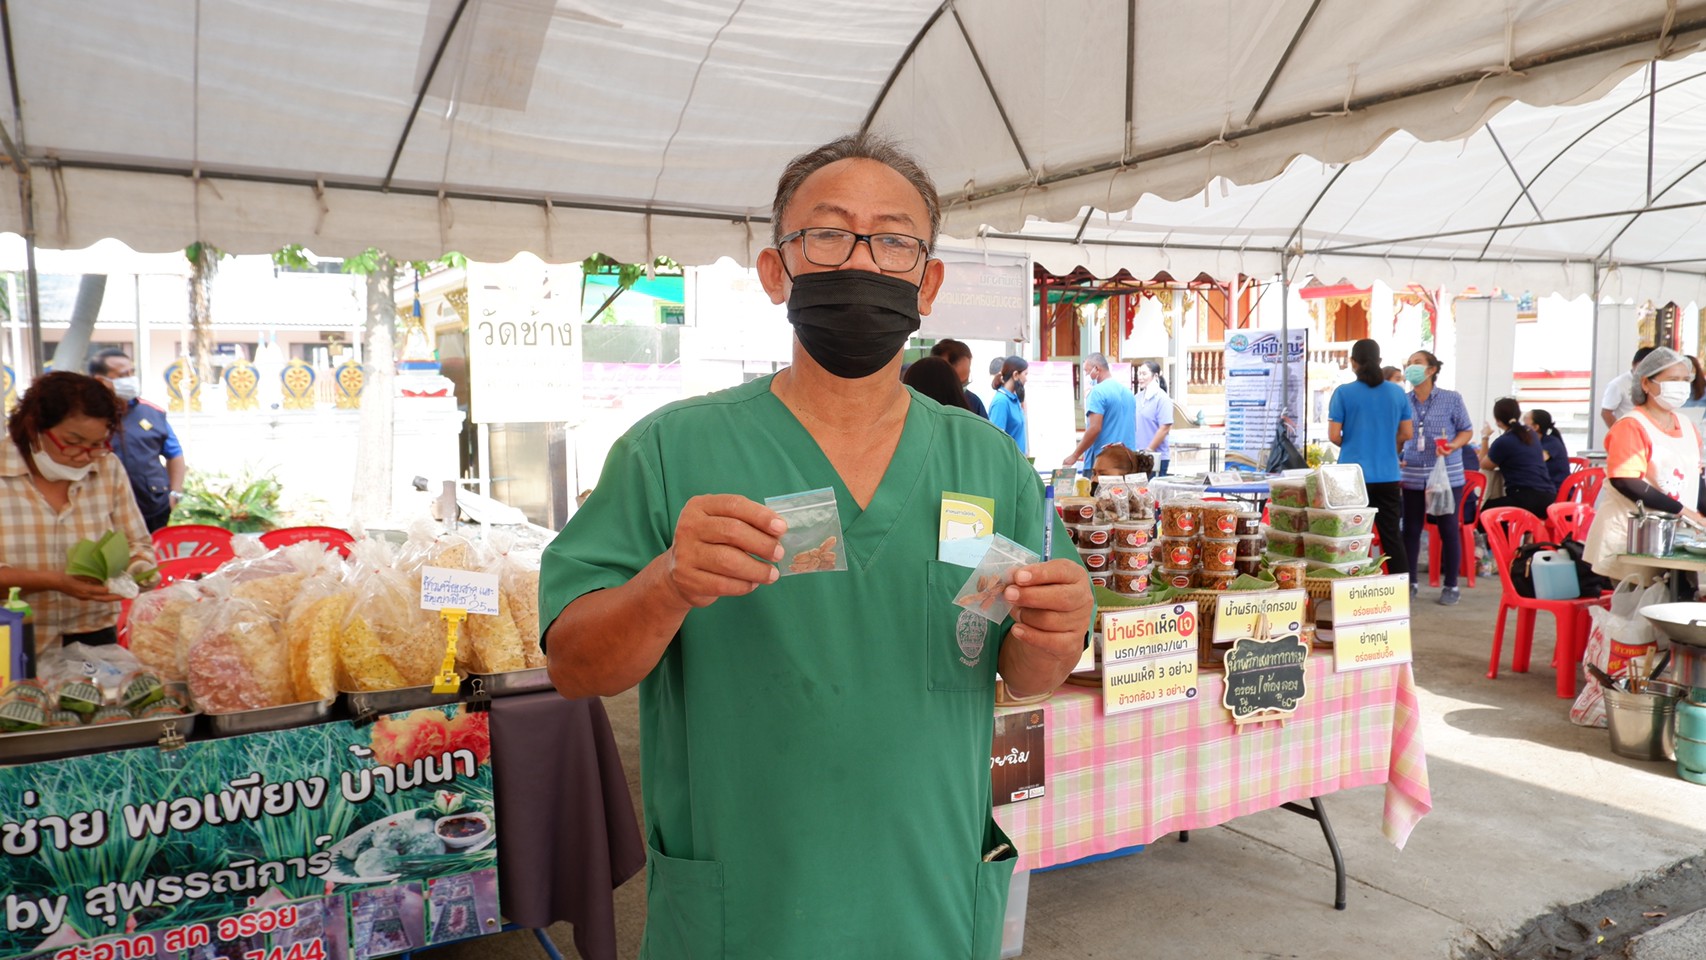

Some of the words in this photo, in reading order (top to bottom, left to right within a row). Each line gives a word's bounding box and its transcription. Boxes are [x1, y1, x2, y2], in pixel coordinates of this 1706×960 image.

[478, 308, 572, 346] วัดช้าง
[1349, 585, 1395, 600] ยำเห็ดกรอบ
[467, 600, 487, 611] 25
[1115, 639, 1188, 660] นรก/ตาแดง/เผา
[1110, 666, 1155, 687] แหนมเห็ด
[1158, 667, 1165, 679] 3
[1168, 661, 1193, 677] อย่าง
[1119, 690, 1155, 706] ข้าวกล้อง
[1158, 688, 1164, 698] 3
[1166, 684, 1186, 698] อย่าง
[989, 747, 1030, 769] ายฉิม
[2, 790, 106, 856] ช่าย
[123, 773, 328, 839] พอเพียง
[341, 745, 478, 803] บ้านนา
[6, 893, 68, 935] by
[85, 834, 333, 927] สุพรรณิการ์
[55, 934, 156, 960] สะอาด
[164, 923, 209, 953] สด
[218, 897, 298, 940] อร่อย
